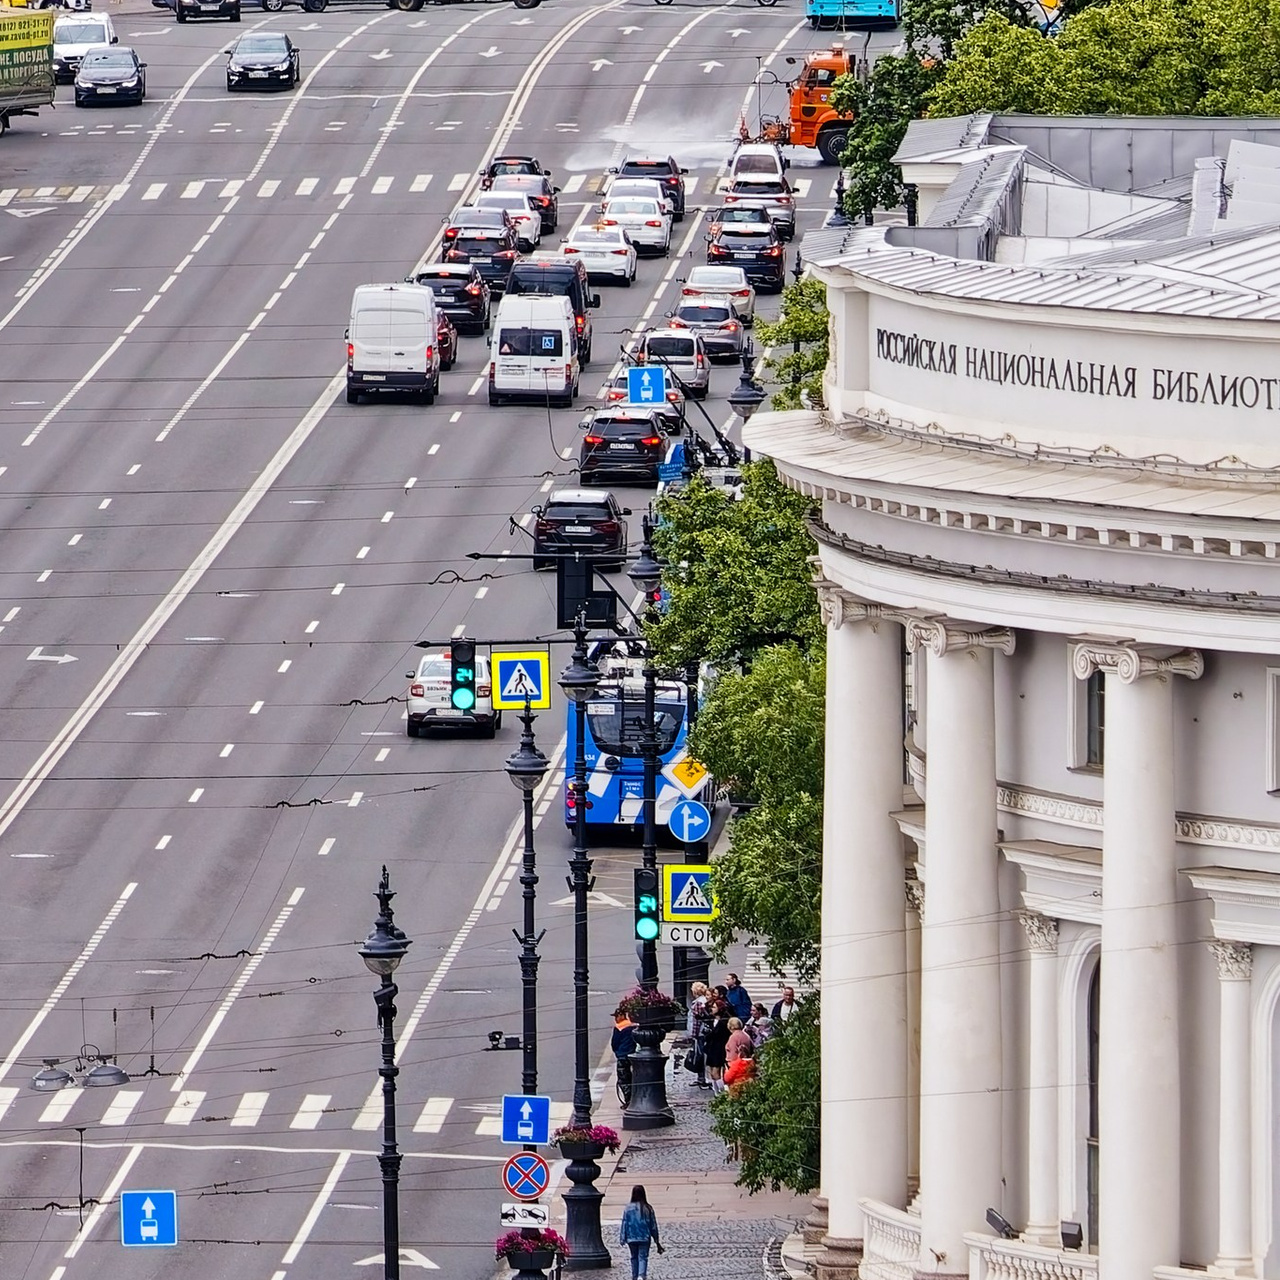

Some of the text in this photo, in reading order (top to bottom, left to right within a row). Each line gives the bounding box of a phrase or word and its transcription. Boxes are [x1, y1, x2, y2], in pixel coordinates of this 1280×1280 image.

[13, 48, 49, 64] ПОСУДА
[876, 328, 958, 375] РОССИЙСКАЯ
[965, 346, 1137, 399] НАЦИОНАЛЬНАЯ
